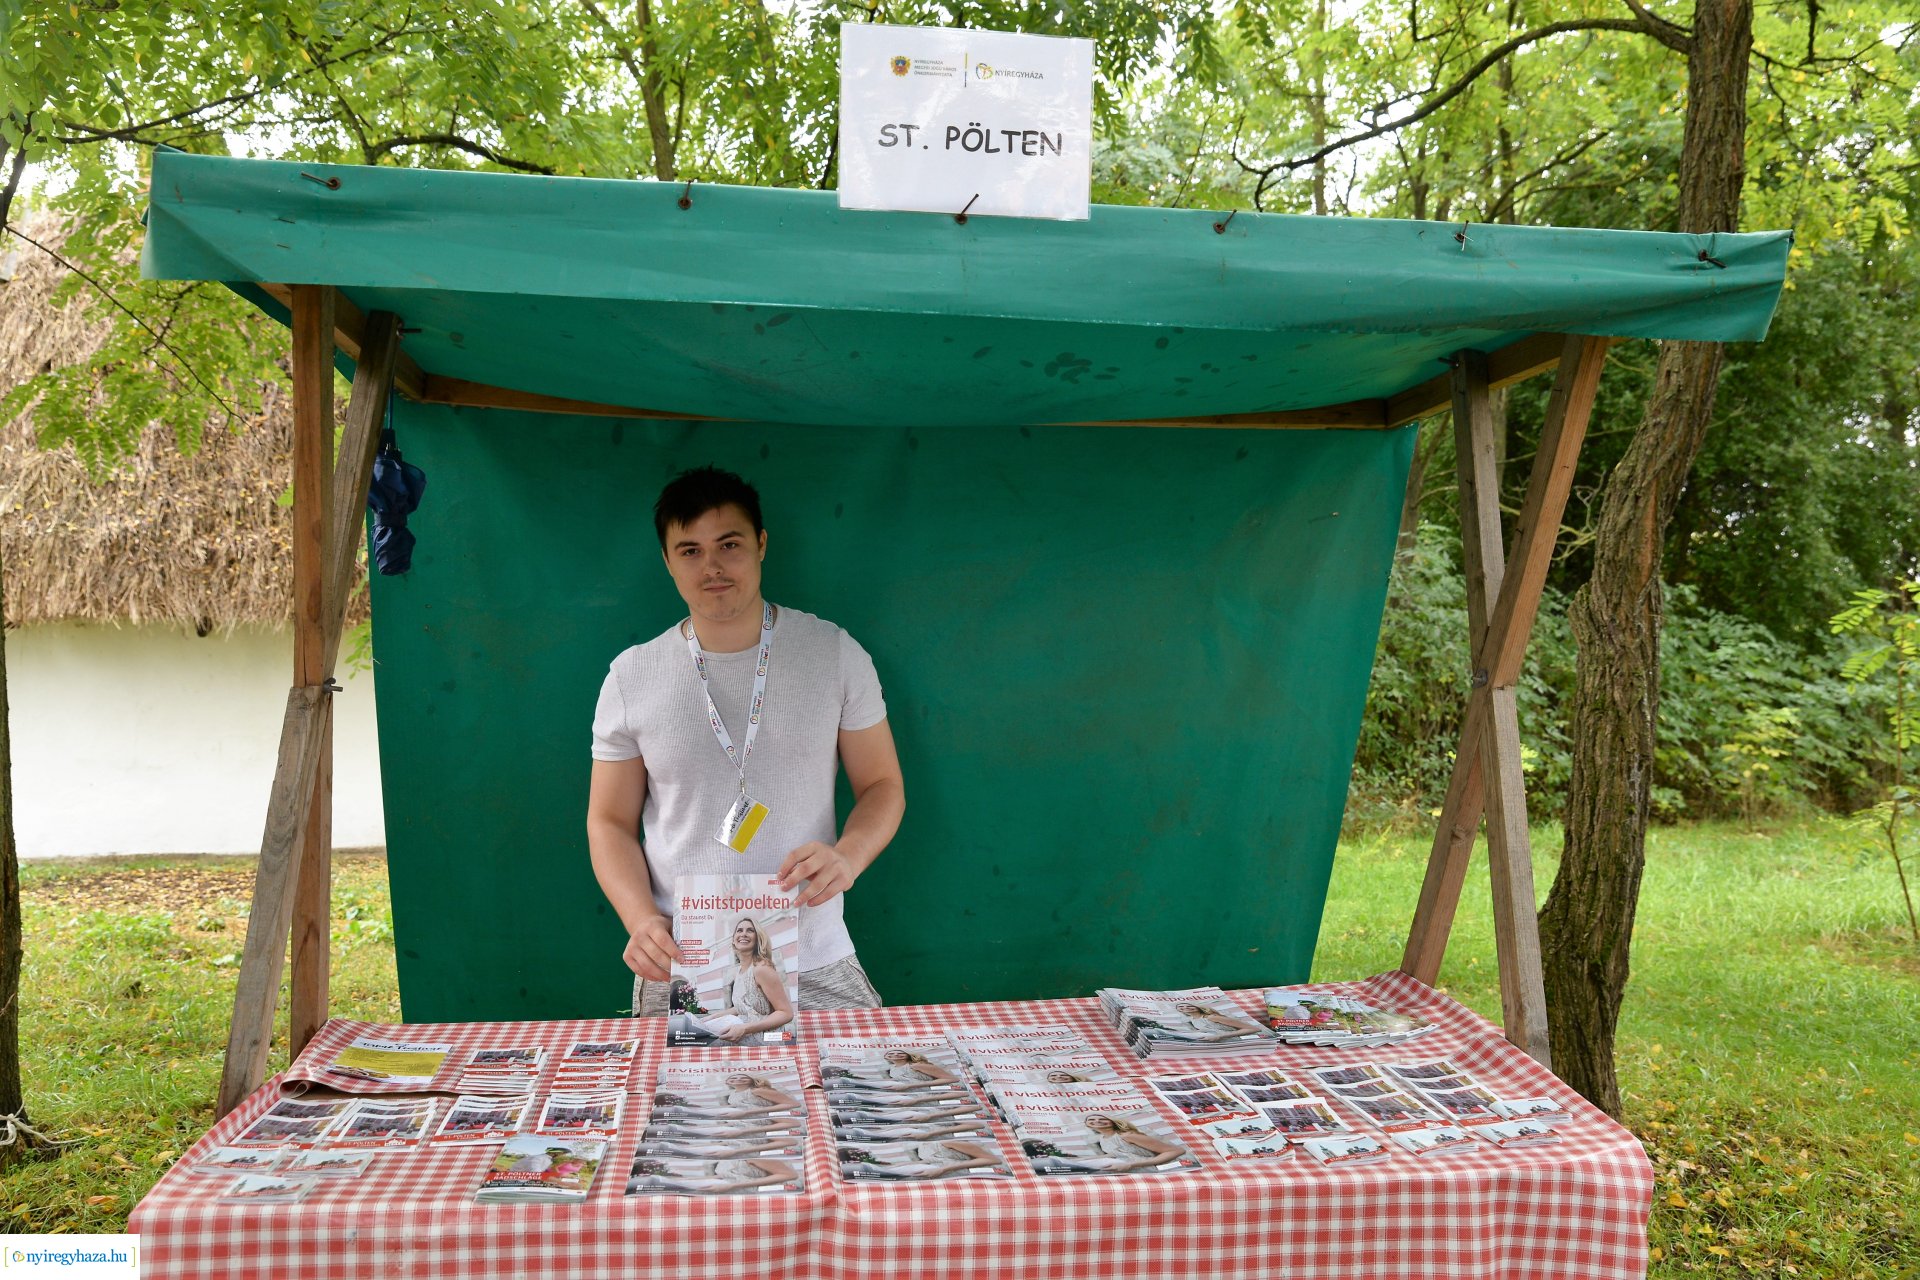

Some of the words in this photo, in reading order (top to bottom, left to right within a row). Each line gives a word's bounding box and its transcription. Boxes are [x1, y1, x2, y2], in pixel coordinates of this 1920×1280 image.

[995, 69, 1044, 80] NYÍREGYHÁZA
[878, 123, 929, 150] ST.
[945, 122, 1063, 157] PÖLTEN
[681, 894, 790, 913] #visitstpoelten
[957, 1030, 1065, 1041] #visitstpoelten
[828, 1041, 942, 1050] #visitstpoelten
[968, 1043, 1081, 1054] #visitstpoelten
[667, 1065, 788, 1074] #visitstpoelten
[984, 1061, 1101, 1071] #visitstpoelten
[1003, 1088, 1128, 1099] #visitstpoelten
[1015, 1102, 1143, 1113] #visitstpoelten
